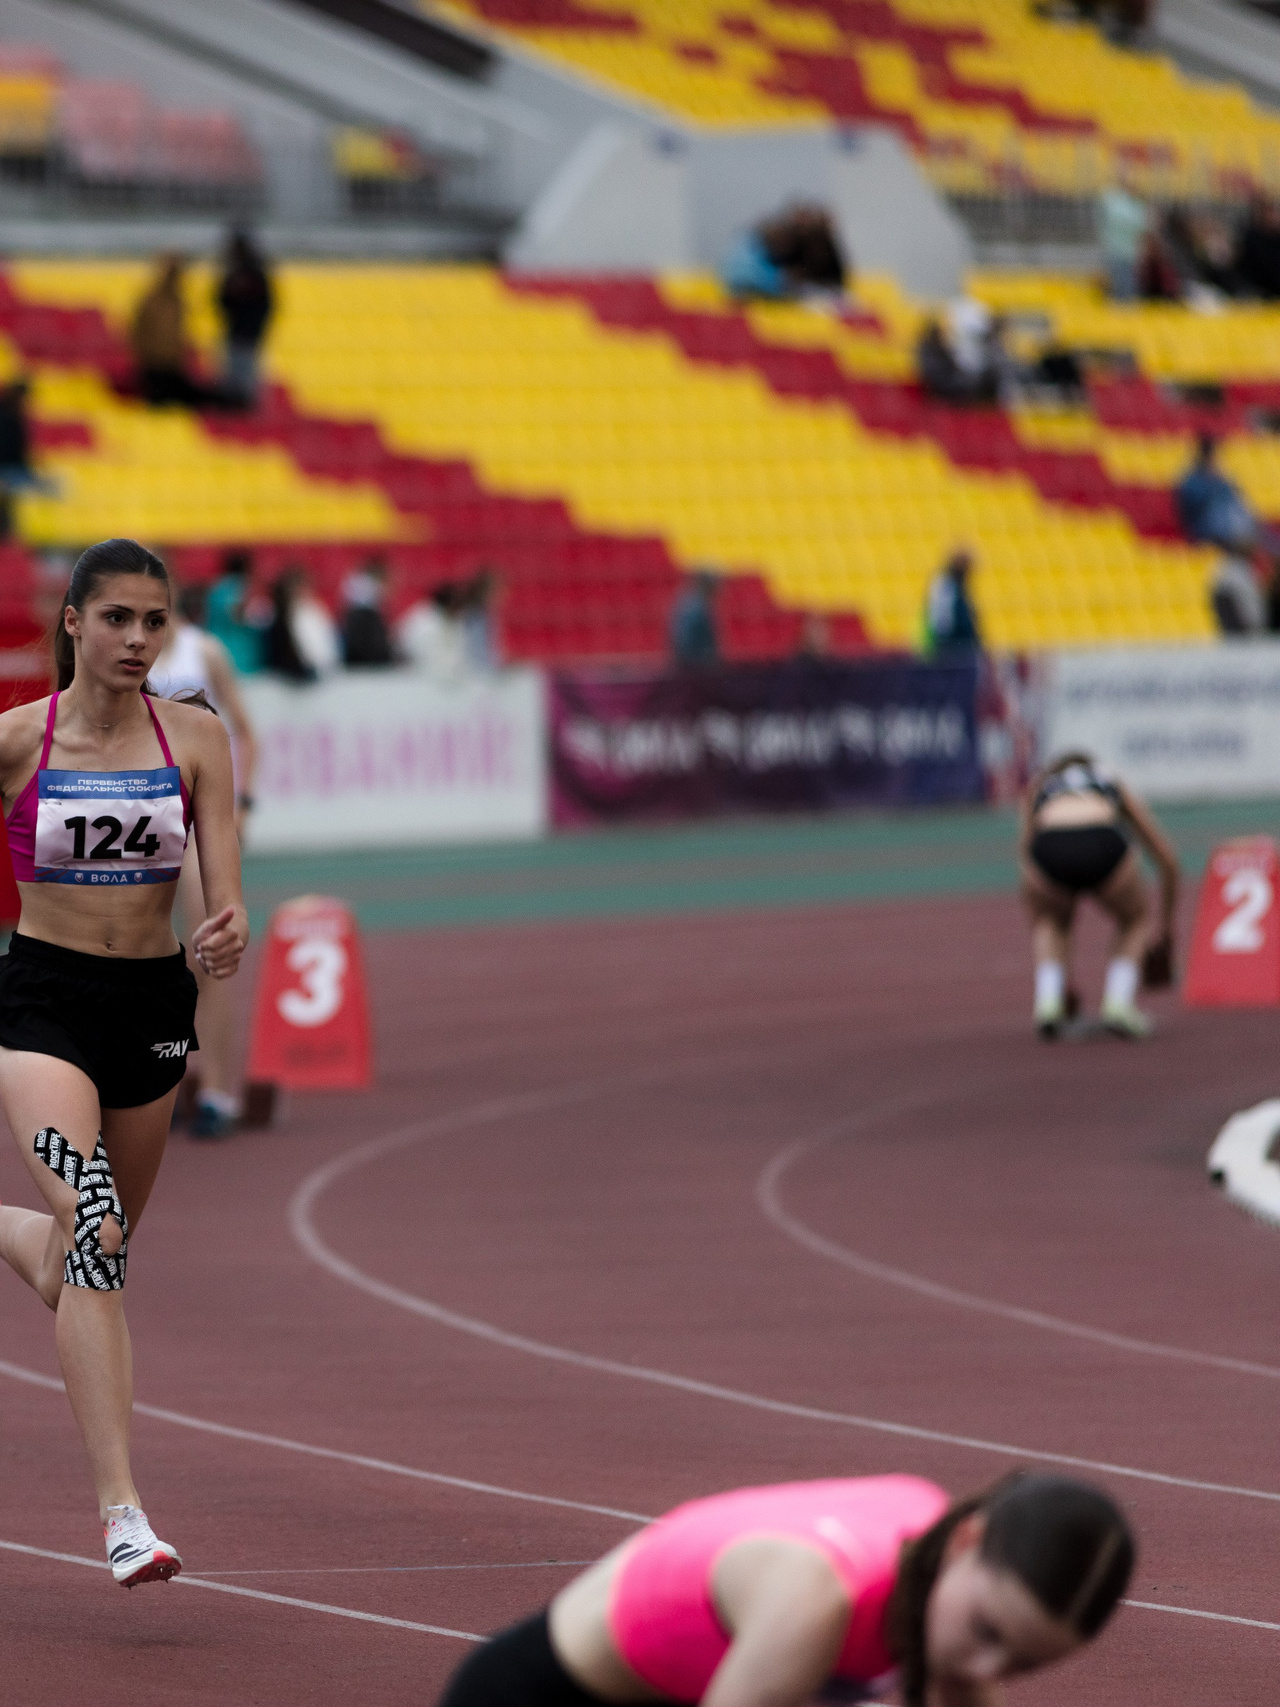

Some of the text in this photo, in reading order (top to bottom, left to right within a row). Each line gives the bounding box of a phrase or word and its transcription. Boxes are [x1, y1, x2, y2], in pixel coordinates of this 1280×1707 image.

[64, 815, 160, 860] 124
[90, 873, 128, 883] ВФЛА
[1212, 868, 1273, 954] 2
[277, 938, 348, 1027] 3
[48, 1132, 63, 1169] ROCKTAPE
